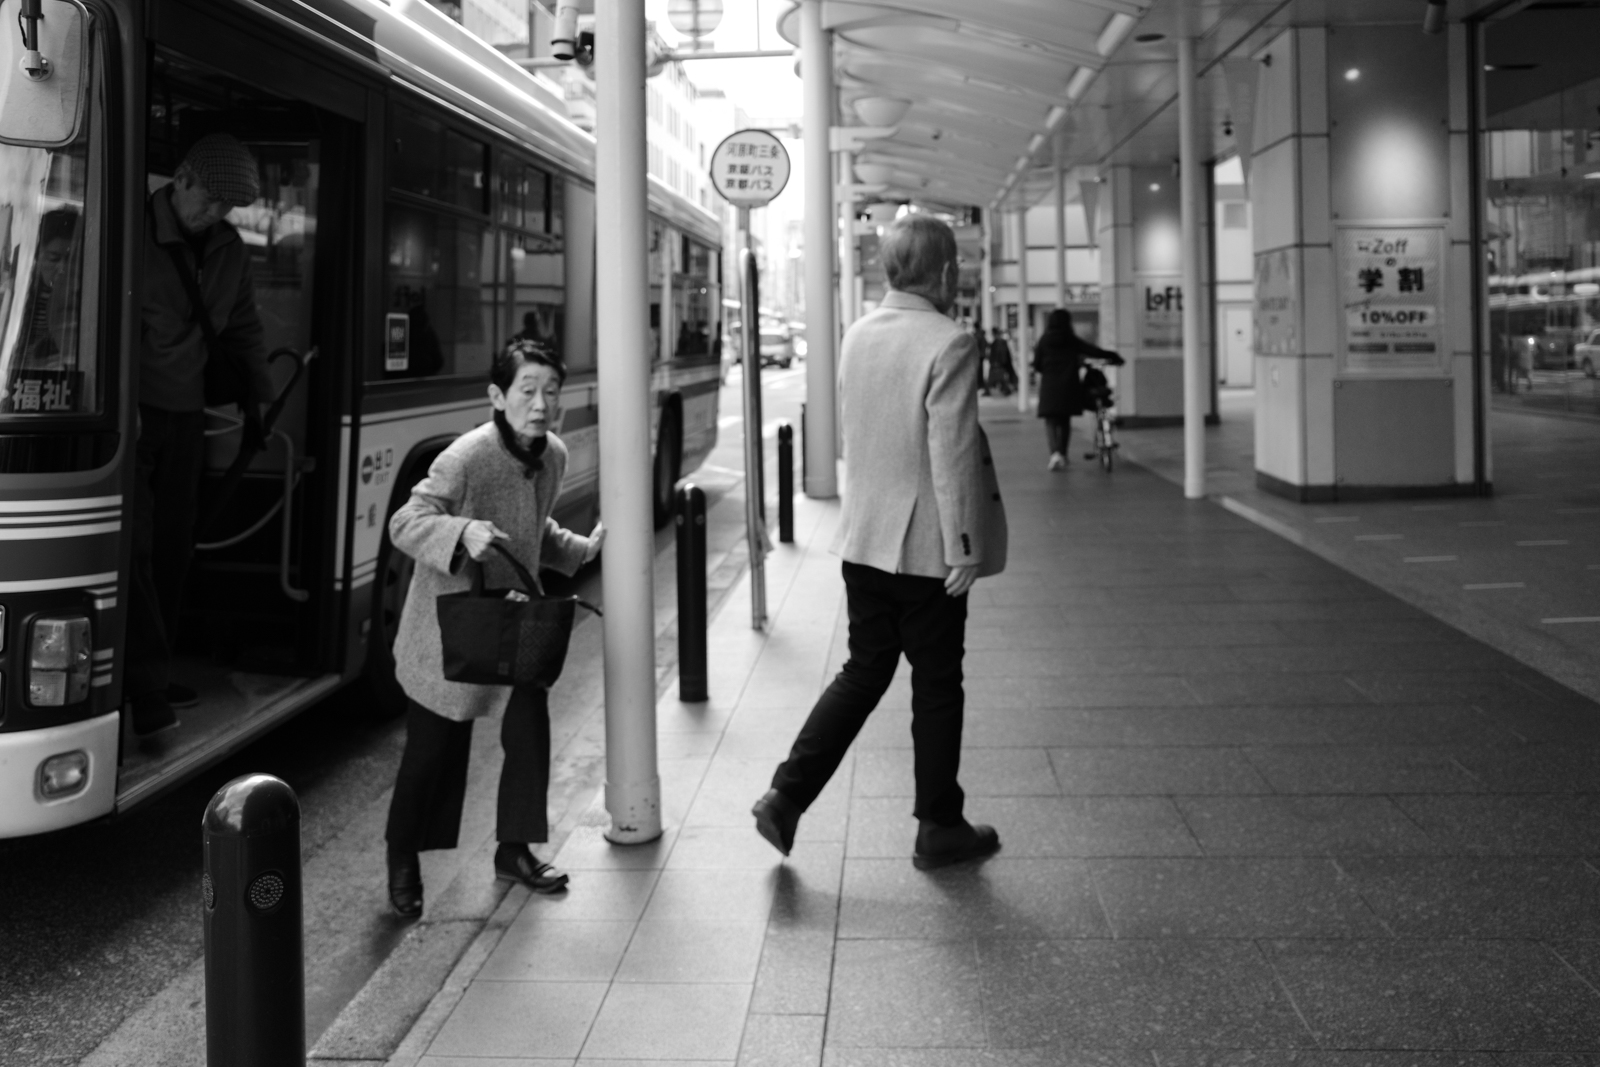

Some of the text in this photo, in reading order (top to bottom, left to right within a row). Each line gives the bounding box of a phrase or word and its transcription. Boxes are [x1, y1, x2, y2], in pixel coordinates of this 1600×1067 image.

[1372, 239, 1408, 255] Zoff
[1358, 266, 1425, 293] 学割
[12, 378, 71, 411] 福祉
